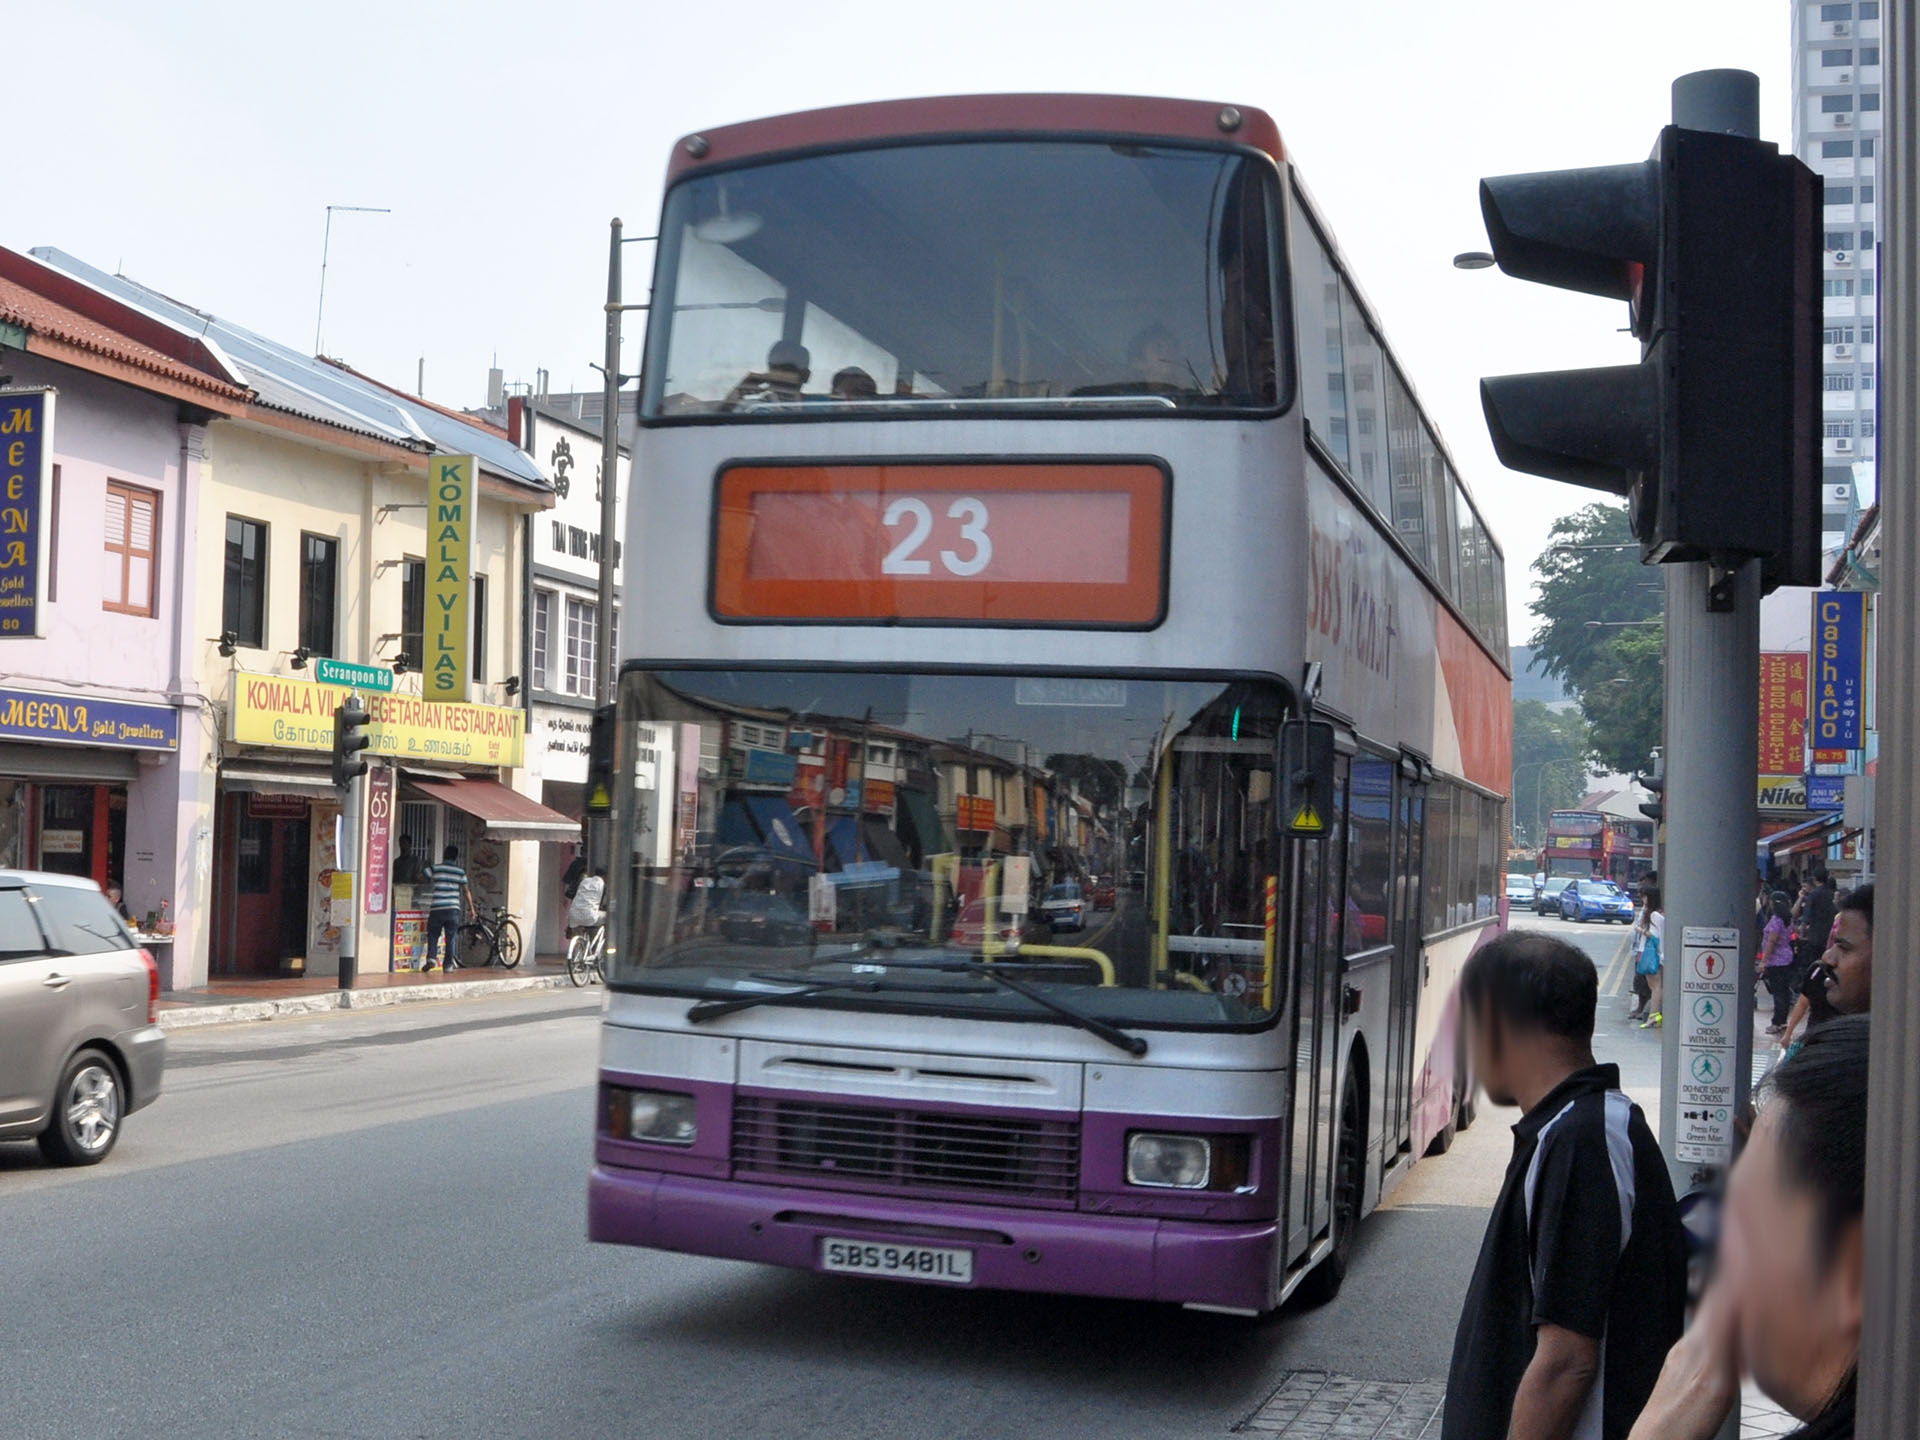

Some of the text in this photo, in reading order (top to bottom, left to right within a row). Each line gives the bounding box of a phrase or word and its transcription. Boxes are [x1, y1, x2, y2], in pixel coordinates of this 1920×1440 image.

[0, 408, 34, 568] MEENA
[881, 497, 993, 577] 23
[0, 576, 25, 593] Gold
[434, 464, 463, 690] KOMALA VILAS
[0, 594, 34, 607] ewellers
[322, 661, 389, 686] Serangoon Rd
[247, 680, 313, 716] KOMALA
[317, 688, 353, 718] VIL
[362, 694, 442, 729] VEGETARIAN
[444, 706, 519, 739] RESTAURANT
[0, 698, 164, 740] MEENA Gold Jewellers
[370, 791, 388, 818] 65
[1759, 787, 1806, 805] Niko
[1685, 981, 1735, 992] DO NOT CROSS
[1688, 1035, 1728, 1045] WITH CARE
[1696, 1027, 1720, 1037] CROSS
[1683, 1085, 1730, 1095] DO NOT START
[1689, 1093, 1723, 1103] TO CROSS
[1686, 1133, 1724, 1142] Green Man
[1690, 1125, 1720, 1134] Press For
[829, 1243, 964, 1278] SBS9481L
